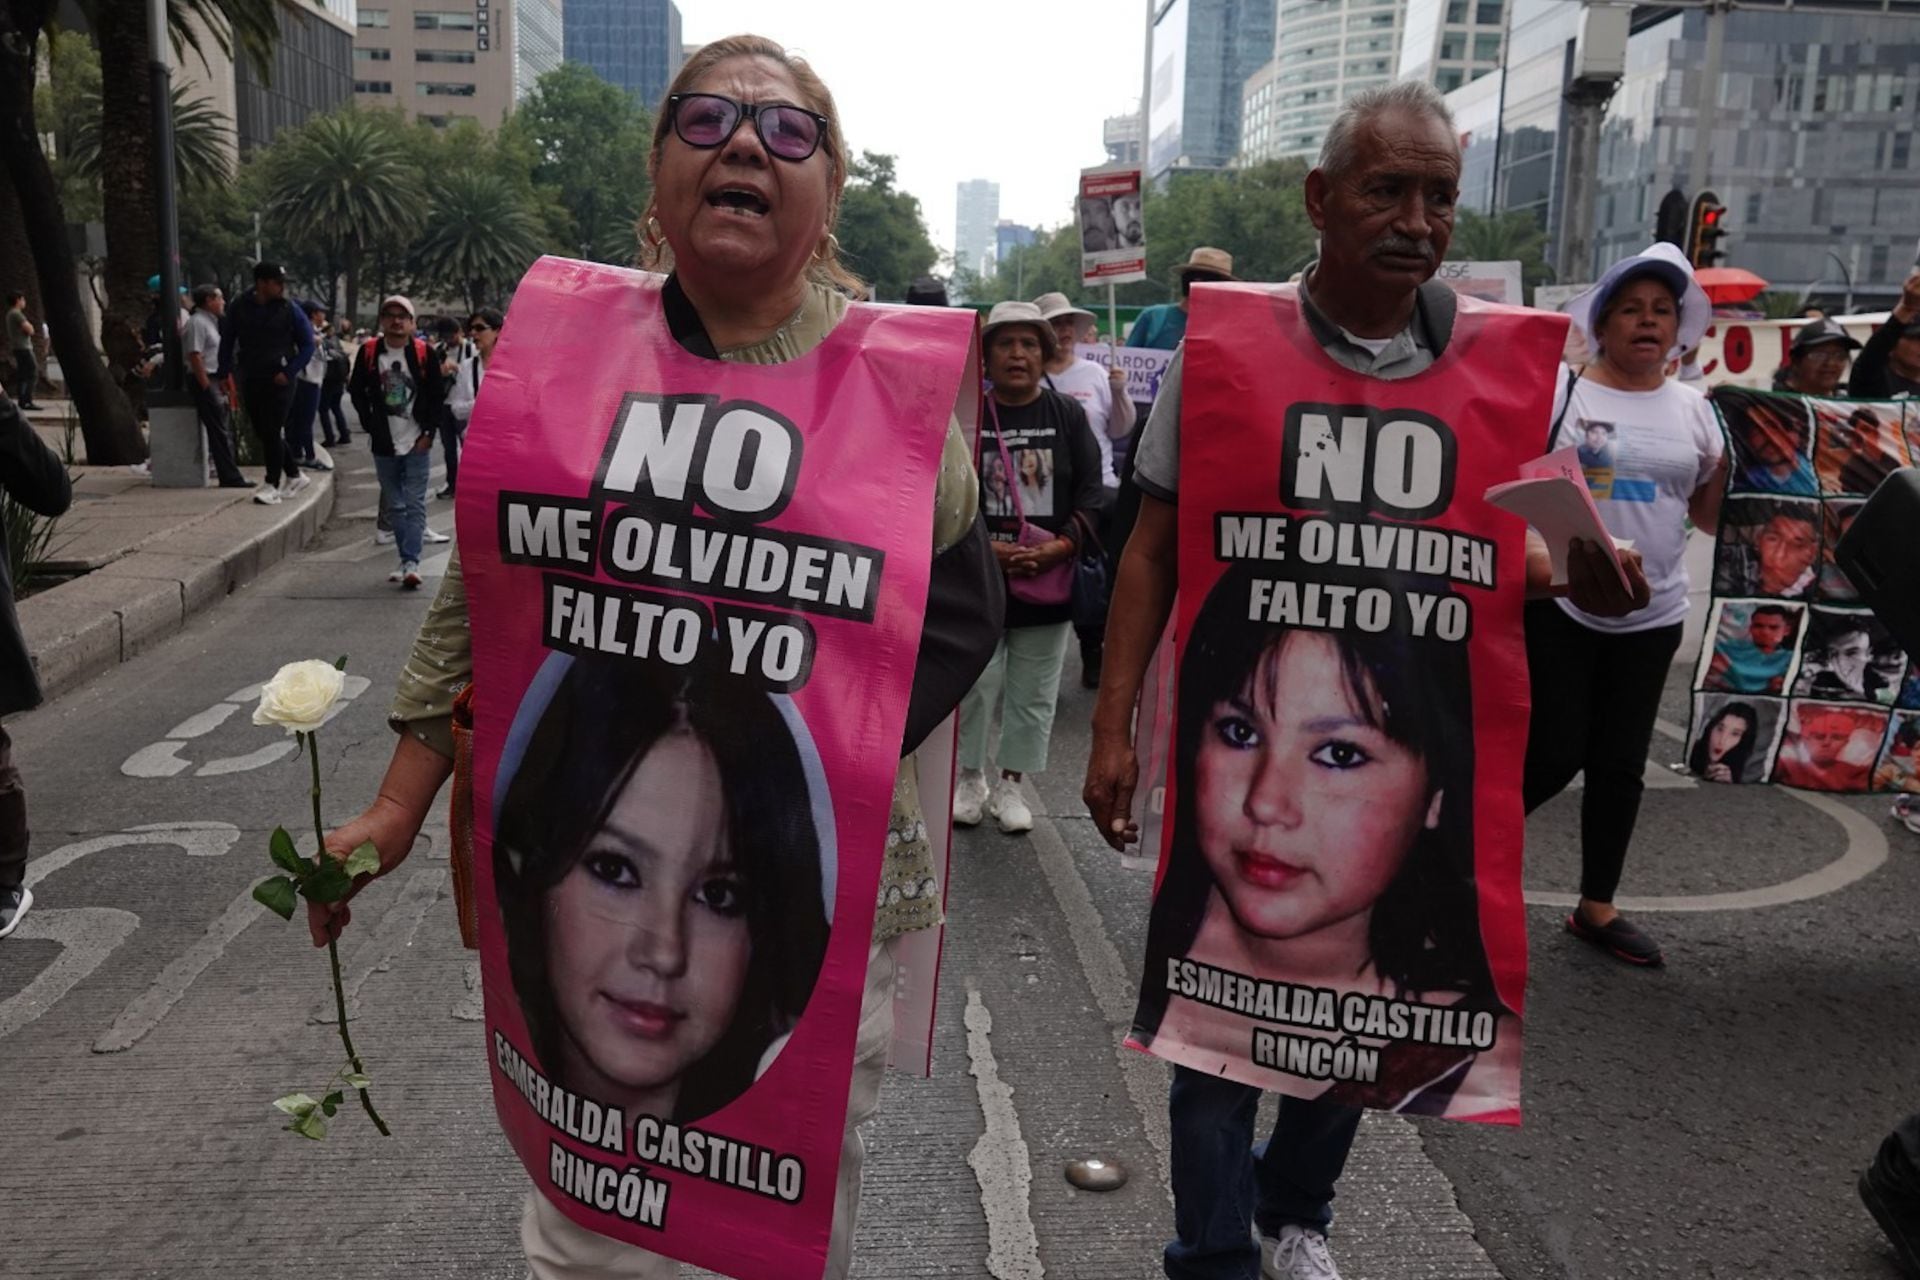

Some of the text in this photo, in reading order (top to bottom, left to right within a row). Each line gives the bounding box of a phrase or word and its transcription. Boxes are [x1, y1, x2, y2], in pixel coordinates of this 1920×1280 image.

[1438, 262, 1472, 279] OSÉ
[602, 400, 792, 512] NO
[1294, 413, 1443, 509] NO
[508, 503, 873, 610] ME OLVIDEN
[1220, 516, 1493, 586] ME OLVIDEN
[550, 585, 805, 682] FALTO YO
[1248, 578, 1467, 641] FALTO YO
[1166, 957, 1494, 1048] ESMERALDA CASTILLO
[1255, 1031, 1379, 1082] RINCÓN
[494, 1031, 801, 1201] ESMERALDA CASTILLO
[551, 1142, 667, 1227] RINCÓN
